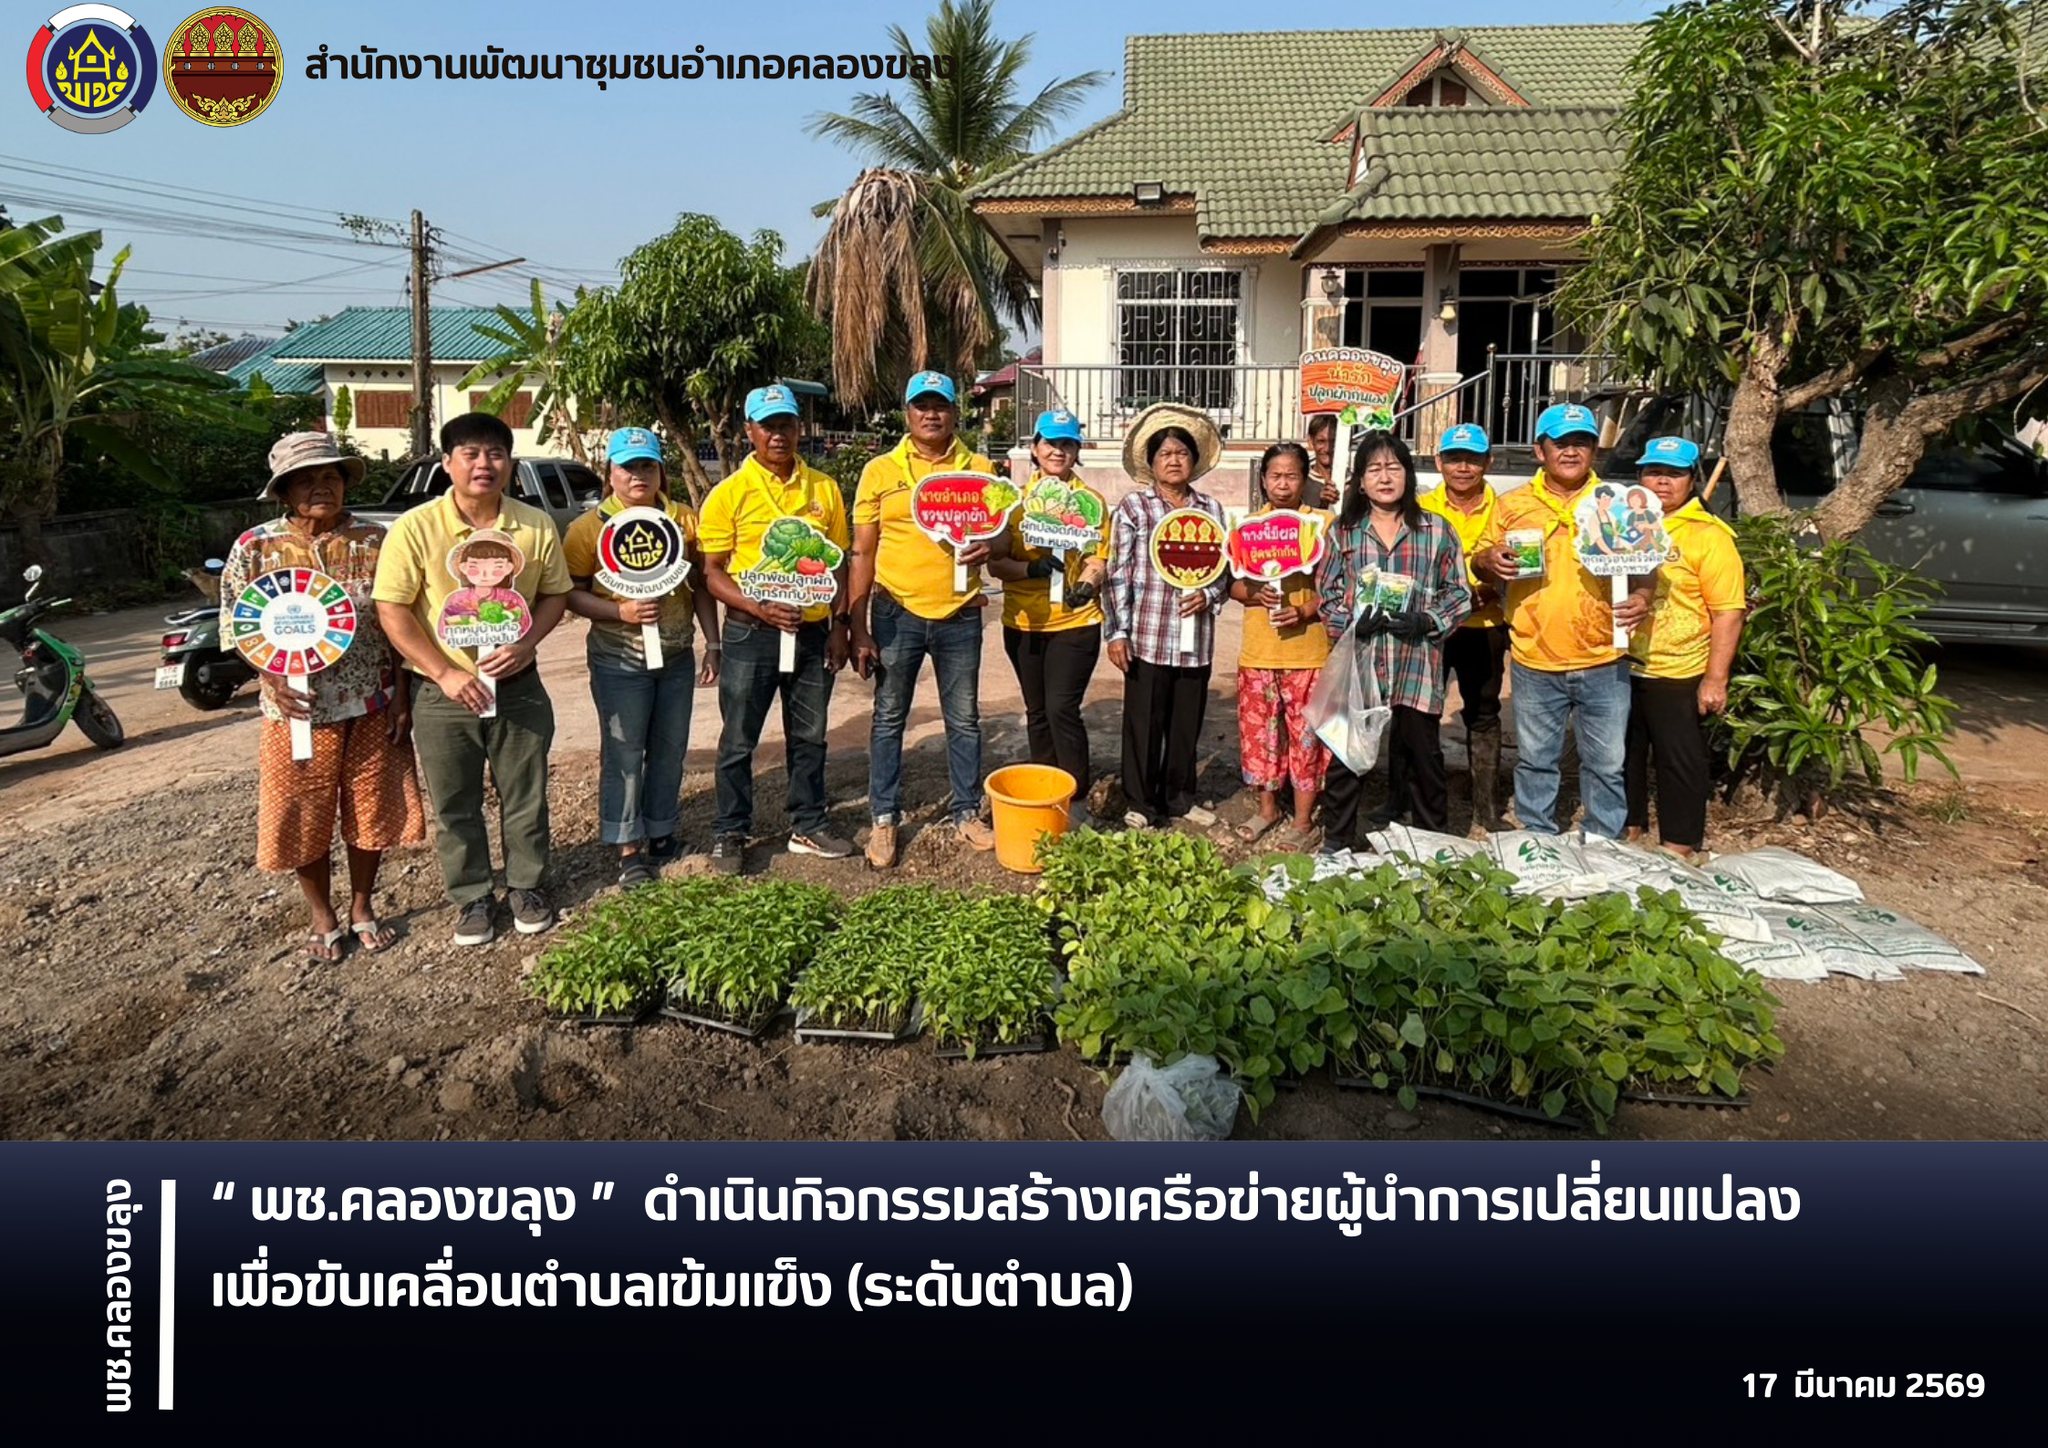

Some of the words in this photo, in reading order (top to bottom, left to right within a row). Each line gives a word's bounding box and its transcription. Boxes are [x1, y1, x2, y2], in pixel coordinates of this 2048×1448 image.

[1303, 350, 1401, 376] คนคลองขลุง
[1328, 361, 1372, 384] น่ารัก
[920, 487, 980, 503] นายอำเภอ
[921, 507, 988, 527] ชวนปลูกผัก
[599, 561, 688, 594] กรมการพัฒนาชุมชน
[739, 570, 832, 587] ปลูกพืชปลูกผัก
[274, 624, 316, 635] GOALS
